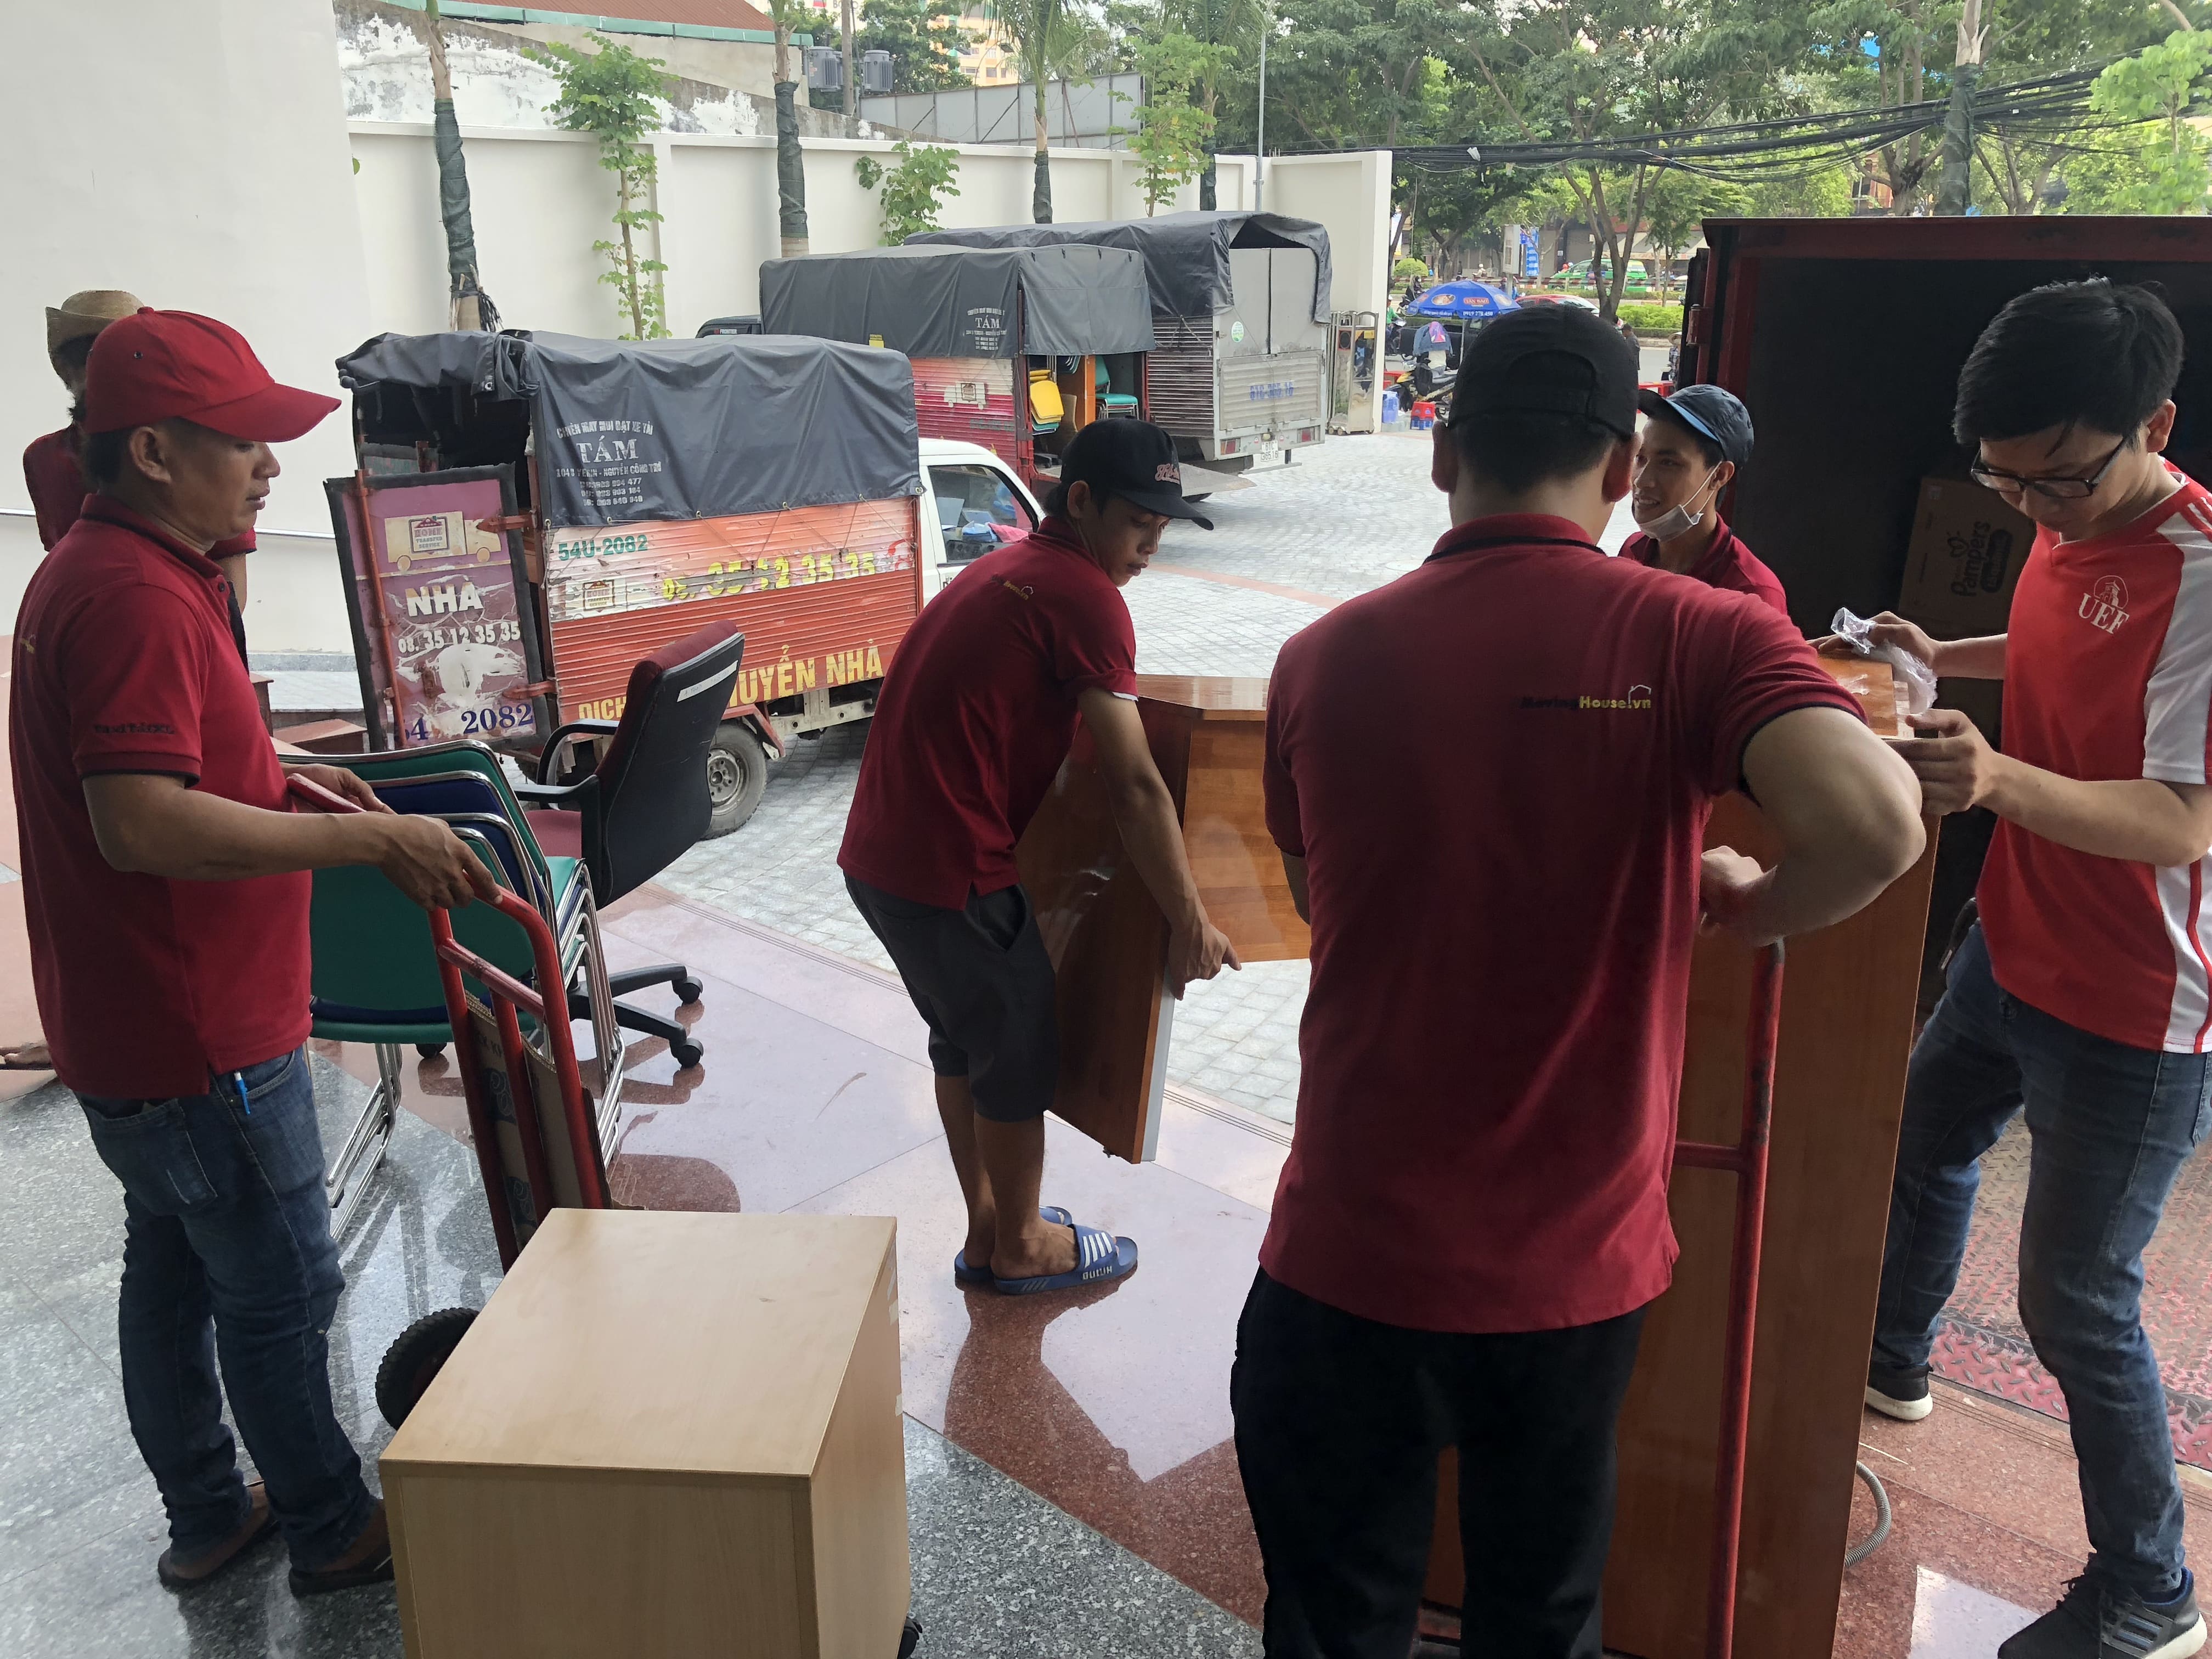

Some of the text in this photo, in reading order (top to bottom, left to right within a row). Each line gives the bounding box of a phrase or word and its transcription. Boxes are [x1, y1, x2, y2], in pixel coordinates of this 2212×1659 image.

[975, 315, 1000, 328] TÁM
[577, 435, 639, 463] TÁM
[558, 534, 648, 561] 54U-2082
[1951, 521, 1992, 598] Pampers
[2079, 592, 2130, 634] UEF
[423, 630, 444, 652] 35
[475, 624, 496, 644] 35
[500, 622, 521, 641] 35
[461, 703, 534, 734] 2082
